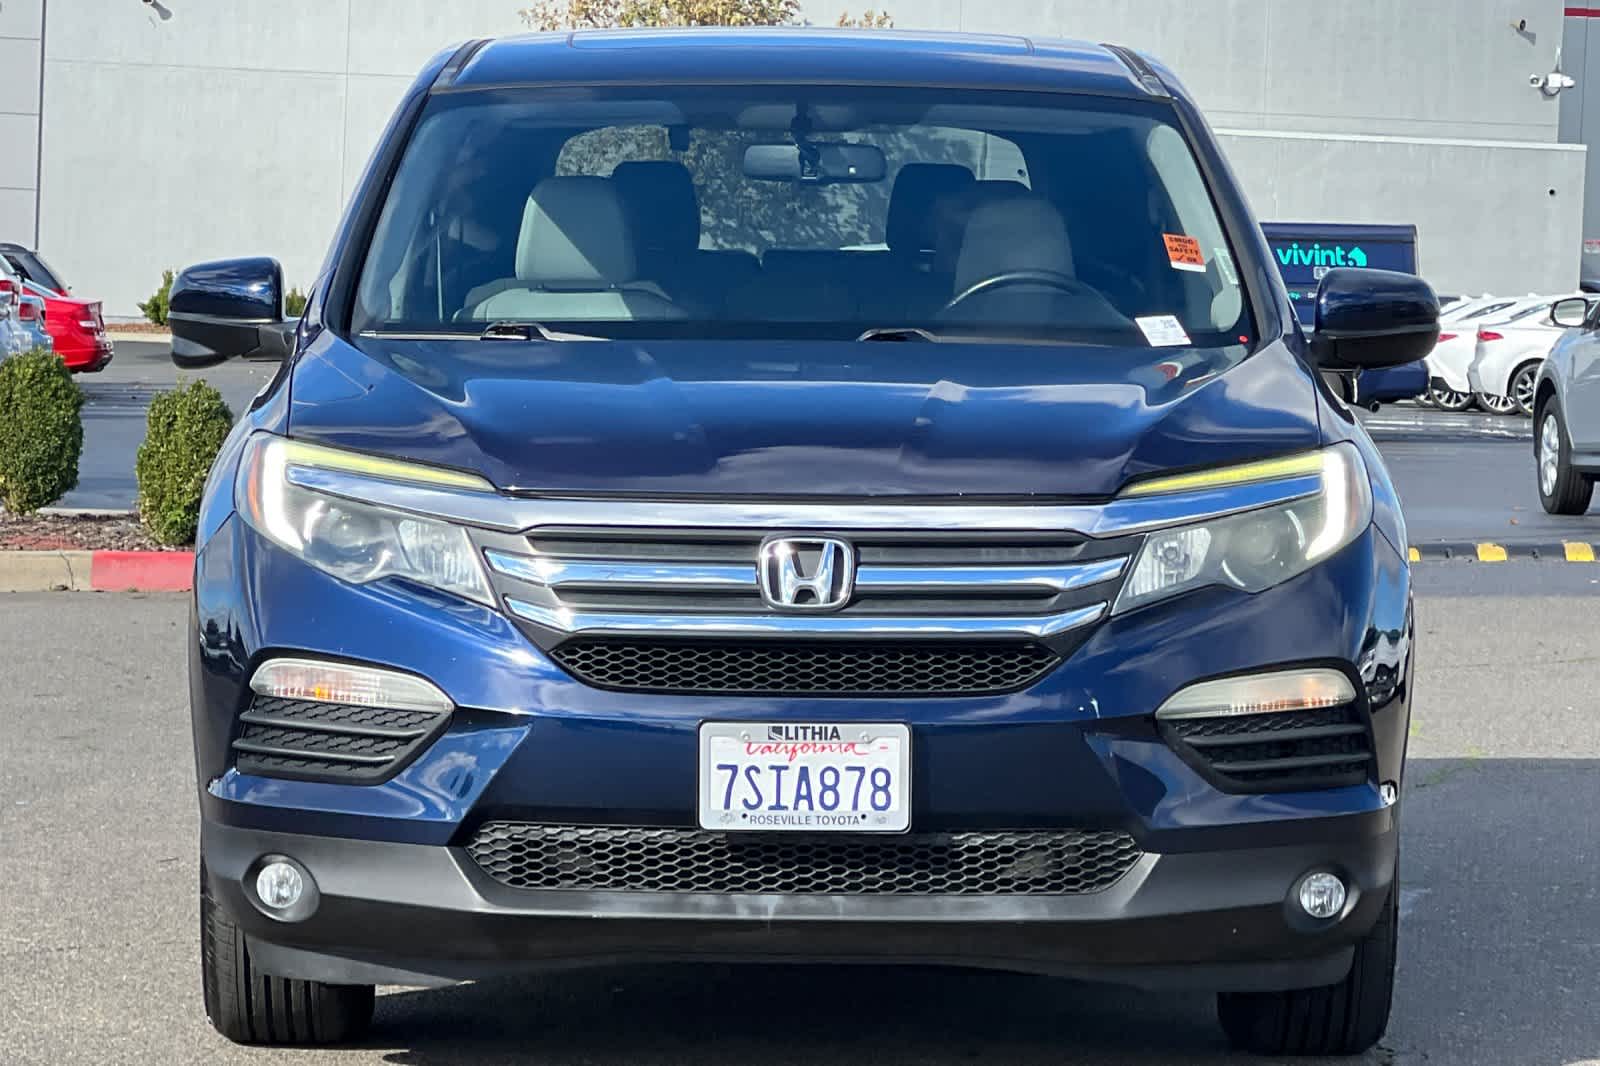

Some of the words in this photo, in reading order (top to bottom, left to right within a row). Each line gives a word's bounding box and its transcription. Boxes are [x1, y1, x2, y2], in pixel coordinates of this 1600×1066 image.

[1276, 243, 1346, 266] vivint
[784, 725, 841, 741] LITHIA
[716, 763, 892, 812] 7SIA878
[749, 815, 811, 825] ROSEVILLE
[816, 815, 860, 825] TOYOTA
